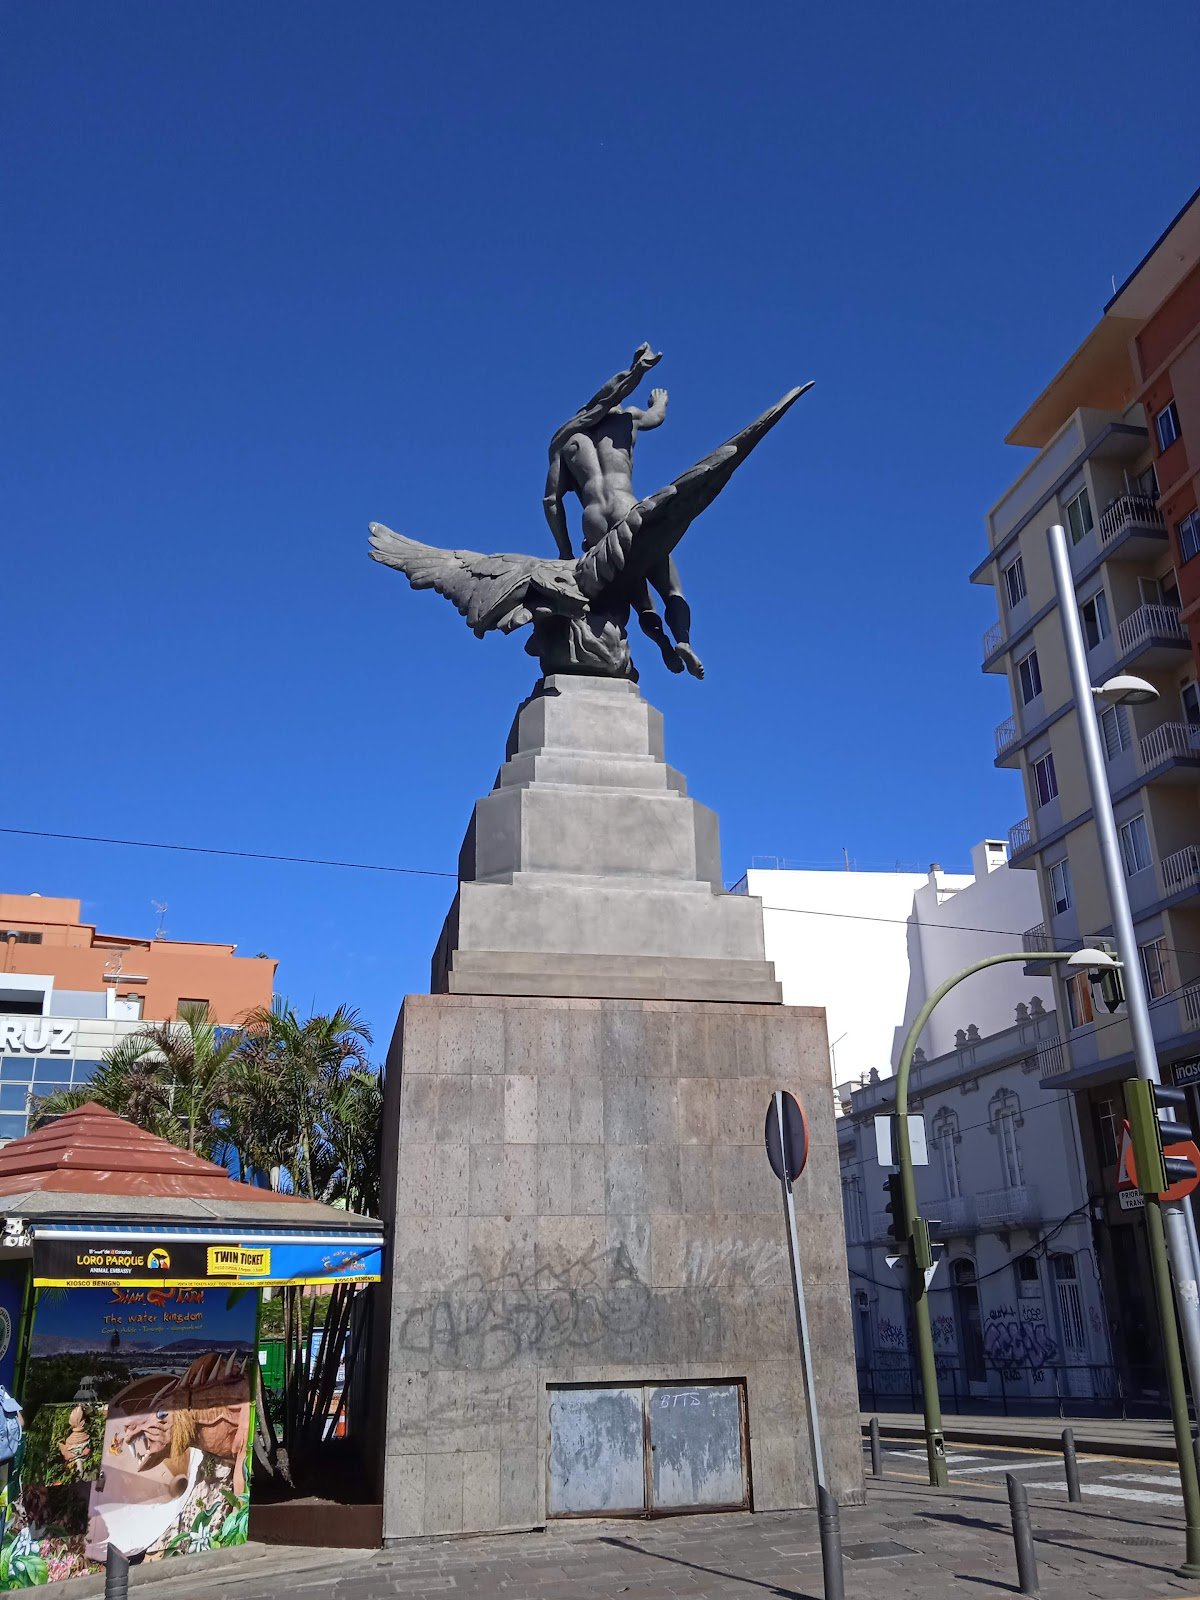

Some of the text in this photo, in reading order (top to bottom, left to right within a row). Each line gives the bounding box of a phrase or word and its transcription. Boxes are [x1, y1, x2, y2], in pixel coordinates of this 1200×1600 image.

[1121, 1189, 1140, 1199] PRIOR
[76, 1255, 144, 1268] LORO PARQUE
[214, 1251, 264, 1265] TWIN TICKET
[104, 1313, 122, 1324] The
[128, 1311, 157, 1323] water
